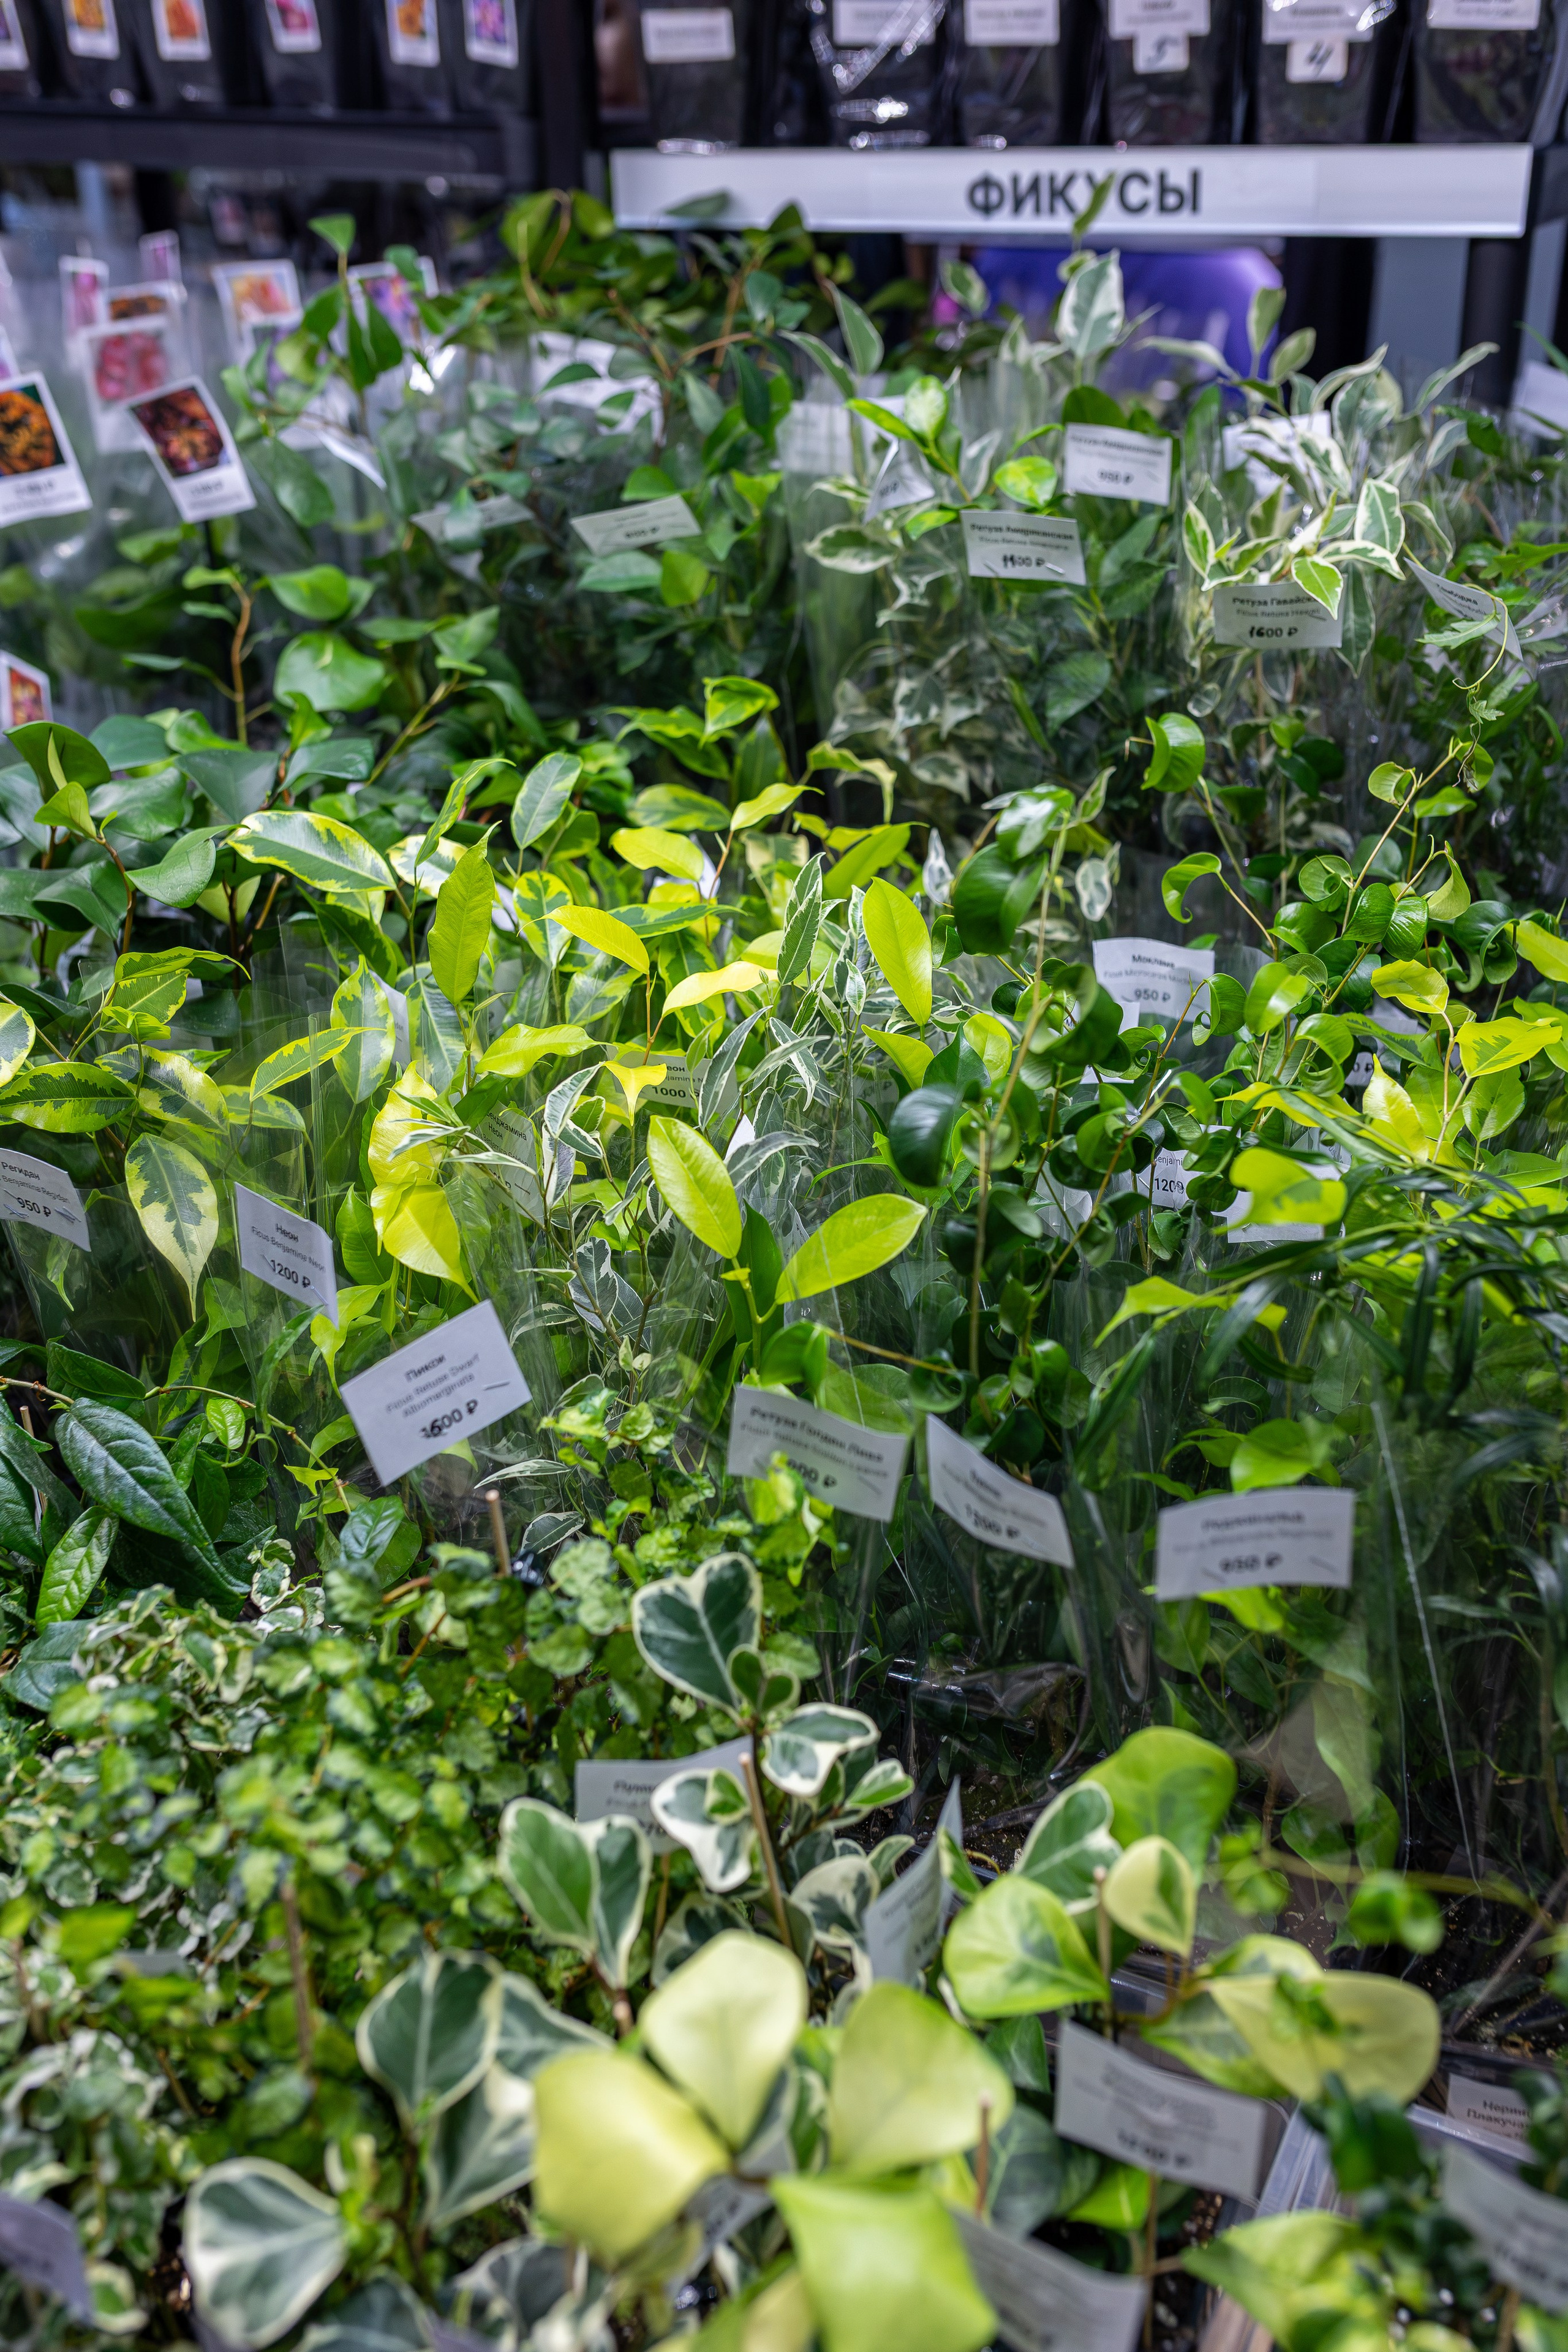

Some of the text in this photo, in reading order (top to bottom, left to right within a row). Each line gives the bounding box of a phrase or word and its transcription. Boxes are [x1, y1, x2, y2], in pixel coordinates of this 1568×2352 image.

[1250, 626, 1283, 638] 1600
[1134, 989, 1159, 1001] 950
[652, 1087, 686, 1098] 1000
[488, 1122, 503, 1140] Неон
[1155, 1156, 1183, 1166] enjami
[1, 1162, 40, 1180] Регидан
[17, 1197, 51, 1218] 950 ₽
[276, 1223, 298, 1243] Неон
[252, 1226, 270, 1242] Ficus
[271, 1237, 307, 1262] Benjamina
[270, 1259, 311, 1288] 1200 ₽
[466, 1398, 478, 1415] ₽
